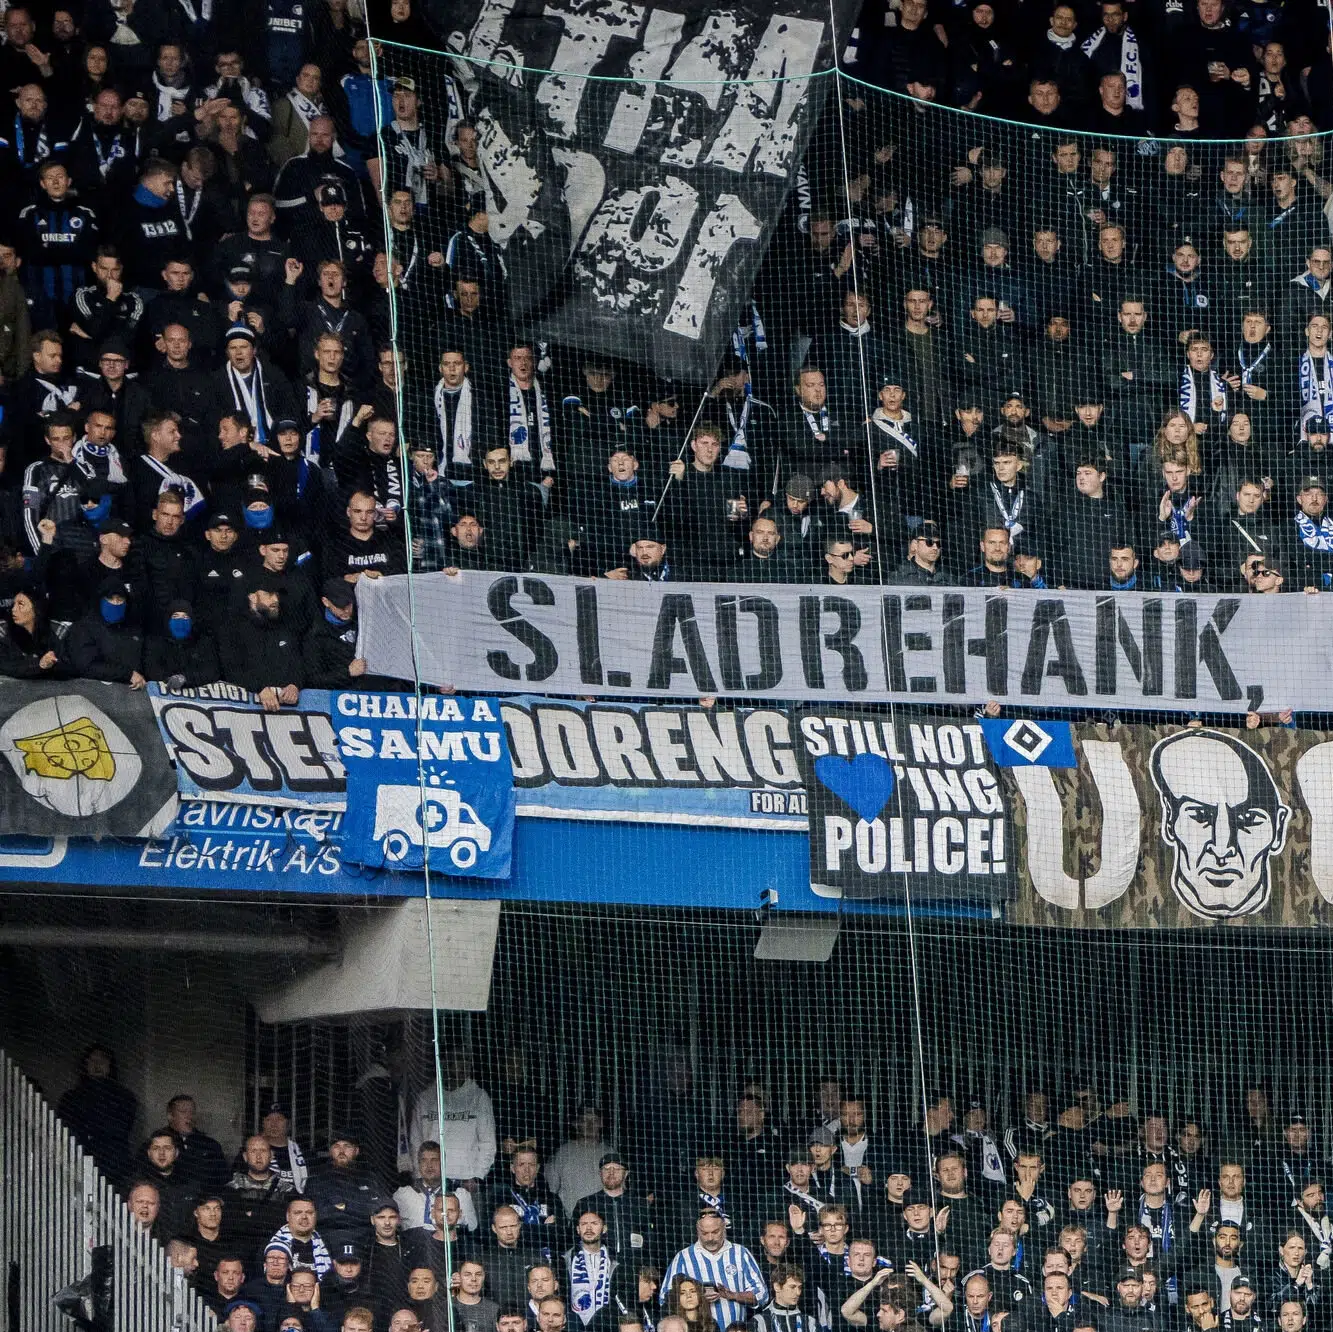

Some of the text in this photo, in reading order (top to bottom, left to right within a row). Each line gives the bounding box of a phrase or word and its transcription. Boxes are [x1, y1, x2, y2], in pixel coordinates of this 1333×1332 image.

[42, 233, 78, 243] UNIBET
[487, 574, 1265, 712] SLADREHANK,
[337, 694, 498, 722] CHAMA A
[340, 727, 502, 763] SAMU
[802, 716, 985, 765] STILL NOT
[751, 791, 787, 813] FOR
[139, 837, 342, 876] Elektrik A/S
[824, 816, 1007, 875] POLICE!
